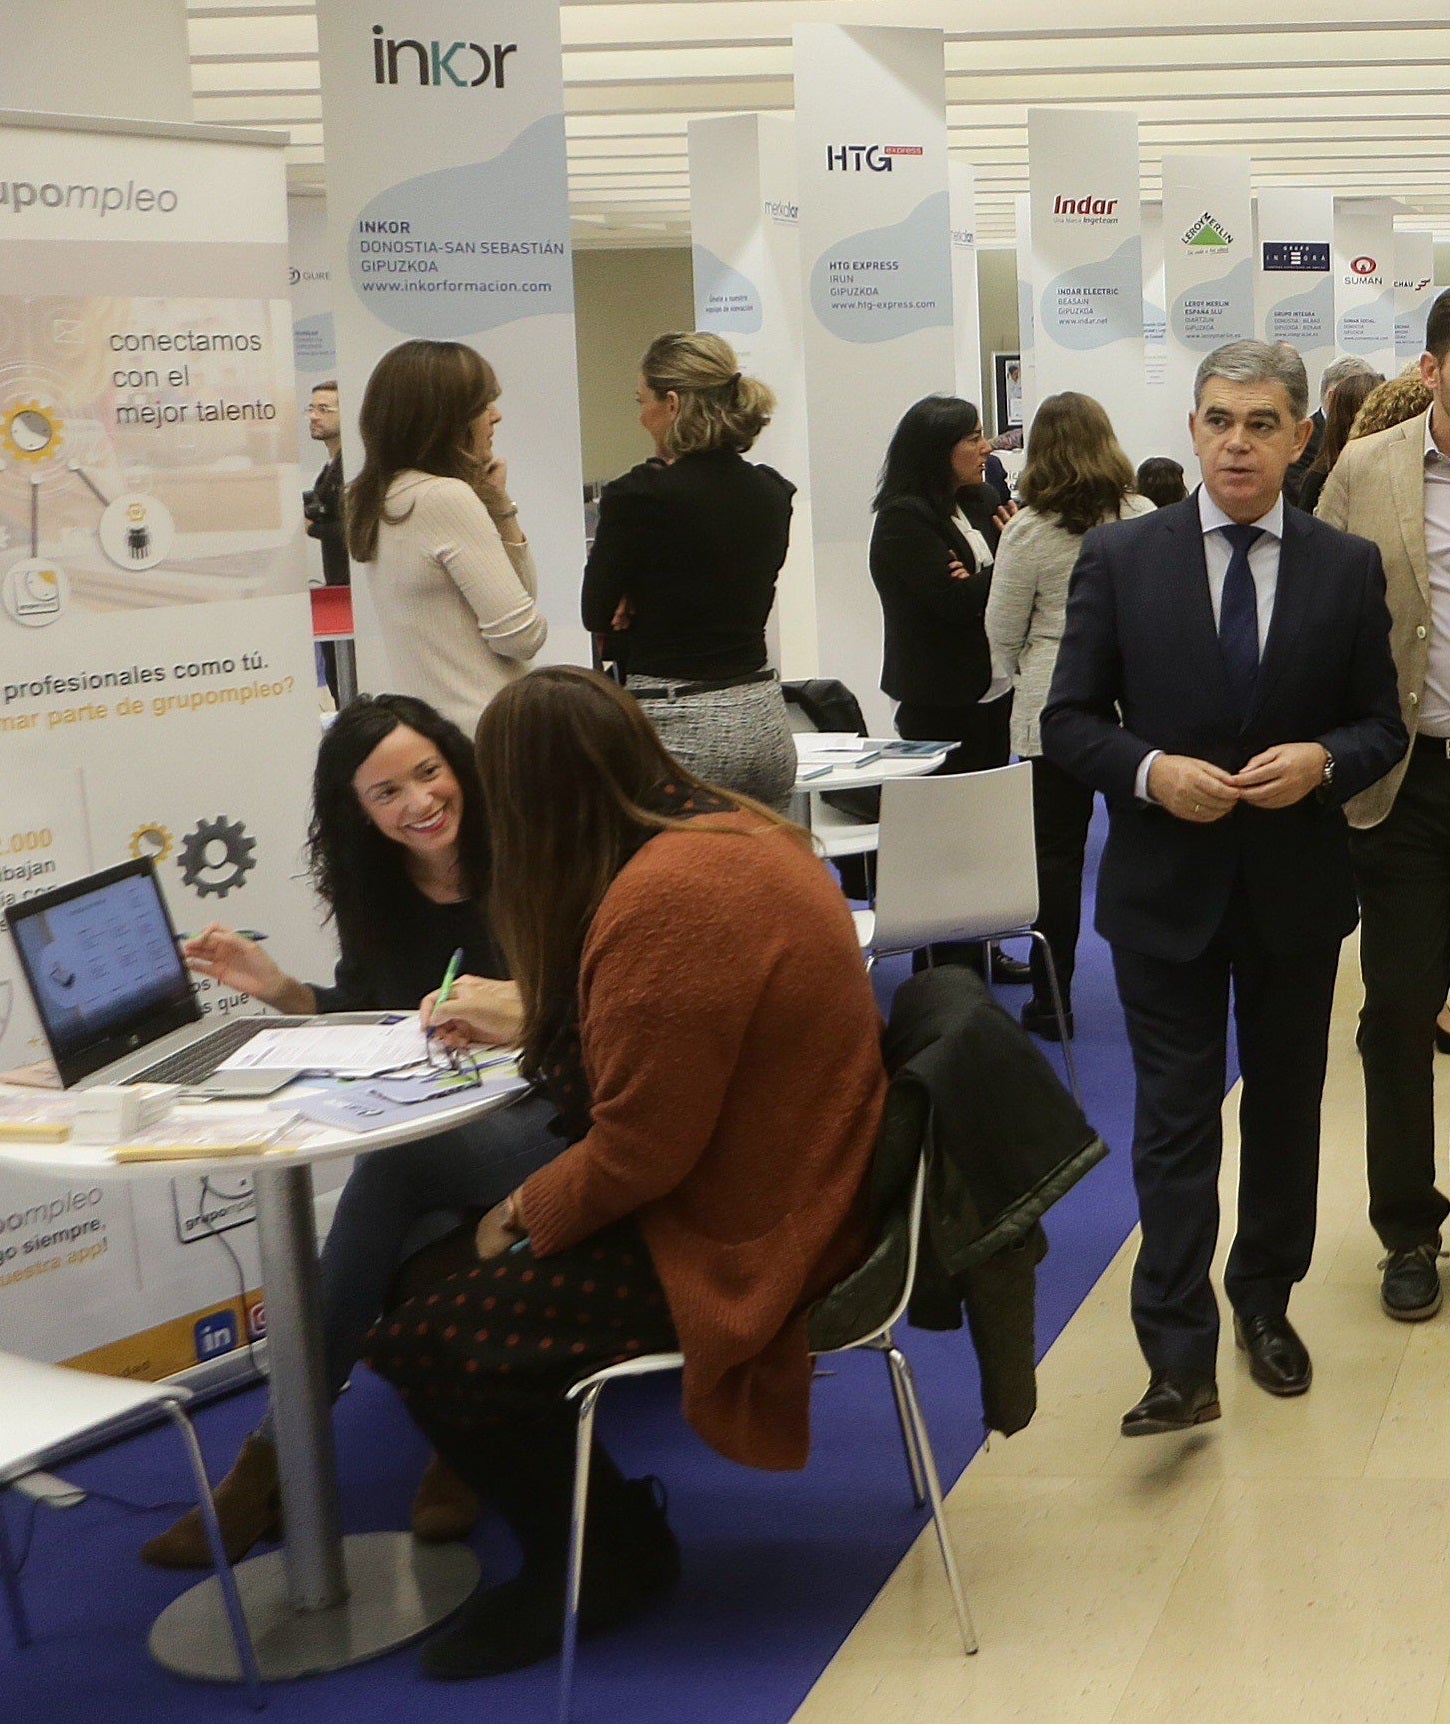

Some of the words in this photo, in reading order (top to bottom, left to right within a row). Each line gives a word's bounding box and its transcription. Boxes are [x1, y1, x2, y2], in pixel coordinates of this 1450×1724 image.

[372, 24, 517, 88] inkor
[827, 145, 892, 172] HTG
[1053, 195, 1118, 214] Indar
[359, 221, 411, 233] INKOR
[1181, 218, 1205, 244] LEROY
[1202, 212, 1234, 244] MERLIN
[360, 240, 476, 254] DONOSTIA-SAN
[361, 260, 439, 273] GIPUZKOA
[829, 261, 850, 270] HTG
[852, 261, 899, 270] EXPRESS
[362, 280, 552, 292] www.inkorformacion.com
[829, 275, 854, 283] IRUN
[830, 287, 879, 296] GIPUZKOA
[831, 300, 936, 310] www.htg-express.com
[110, 331, 262, 351] conectamos
[113, 370, 159, 387] con
[168, 365, 190, 387] el
[116, 402, 188, 429] mejor
[197, 399, 276, 422] talento
[5, 666, 166, 705] profesionales
[173, 656, 236, 680] como
[242, 651, 269, 671] tú.
[48, 702, 108, 729] parte
[116, 696, 144, 717] de
[152, 675, 296, 717] grupompleo?
[0, 828, 53, 856] .000
[0, 859, 56, 881] bajan
[218, 992, 250, 1015] que
[22, 1218, 106, 1254] siempre,
